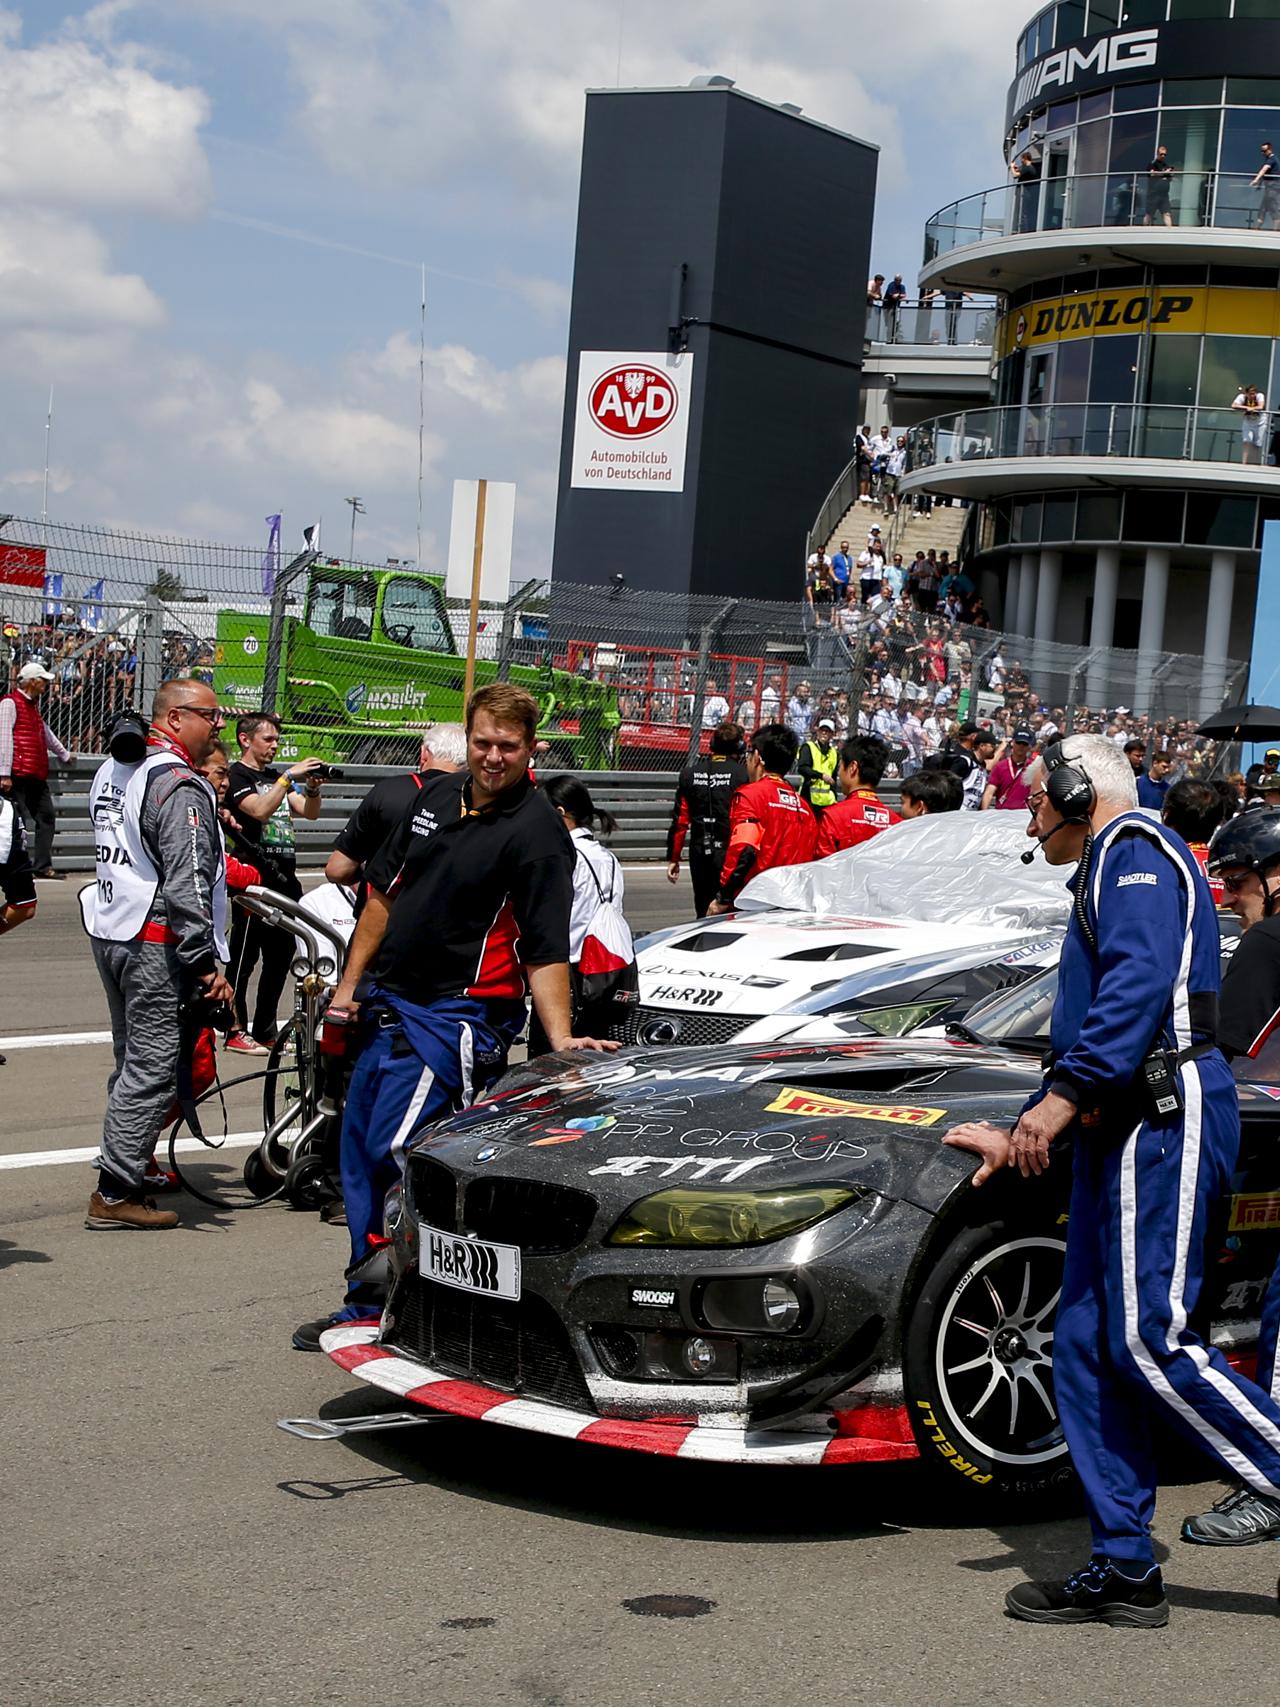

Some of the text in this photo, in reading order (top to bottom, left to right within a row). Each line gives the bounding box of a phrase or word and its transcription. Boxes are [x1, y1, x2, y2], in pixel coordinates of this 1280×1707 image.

[1031, 296, 1194, 337] DUNLOP
[590, 450, 668, 465] Automobilclub
[584, 466, 672, 481] von Deutschland
[245, 639, 257, 651] 20
[95, 844, 133, 867] EDIA
[667, 968, 743, 982] LEXUS
[649, 985, 697, 1002] H&R
[783, 1095, 930, 1122] PIRELLI
[601, 1122, 868, 1163] PP GROUP
[429, 1232, 472, 1286] H&R
[631, 1289, 675, 1305] SWOOSH
[916, 1399, 994, 1485] PIRELLI
